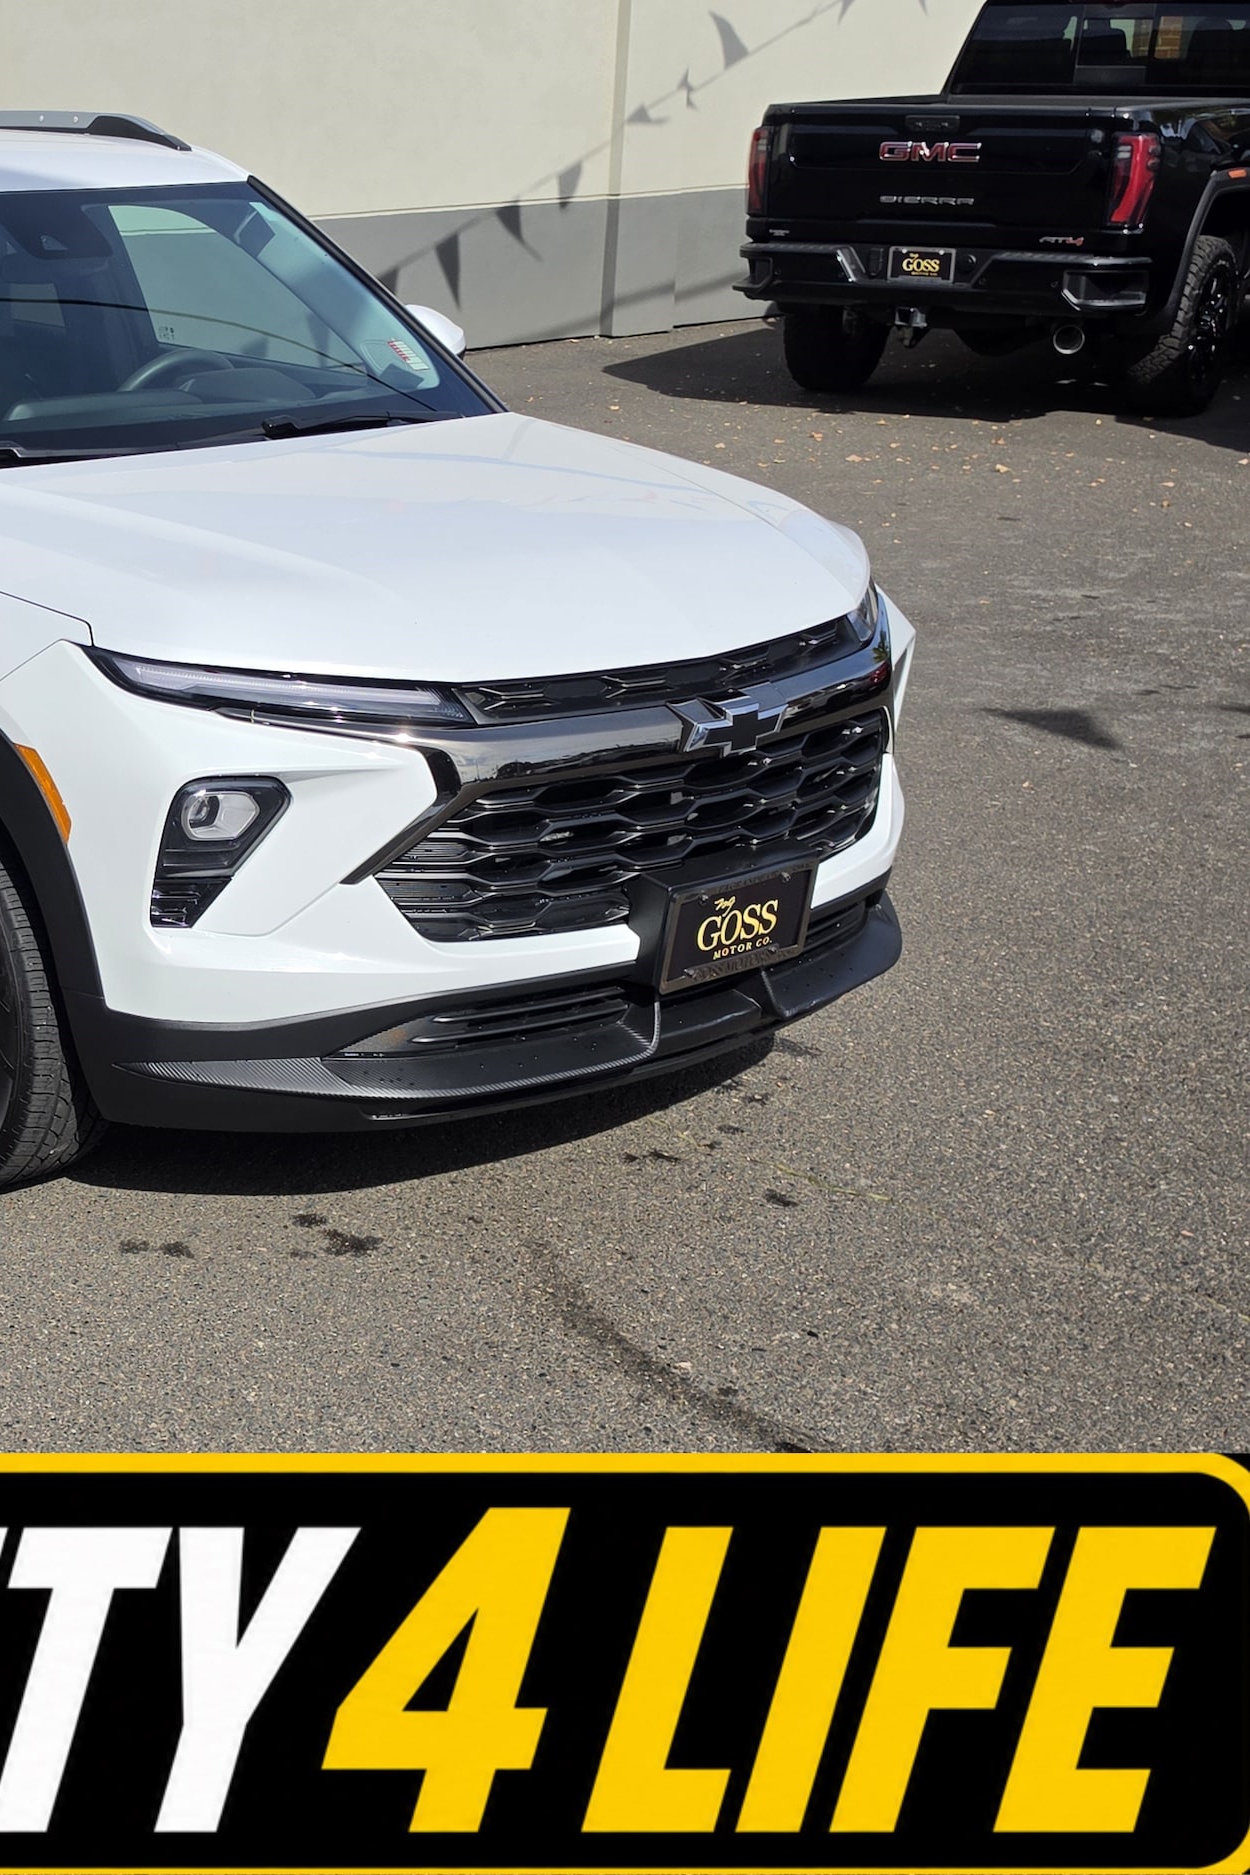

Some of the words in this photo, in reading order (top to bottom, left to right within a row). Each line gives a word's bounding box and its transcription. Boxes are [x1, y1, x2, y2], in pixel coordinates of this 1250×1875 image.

[879, 141, 982, 162] GMC
[902, 258, 940, 272] GOSS
[697, 899, 779, 952] GOSS
[713, 942, 752, 960] MOTOR
[755, 936, 773, 949] CO.
